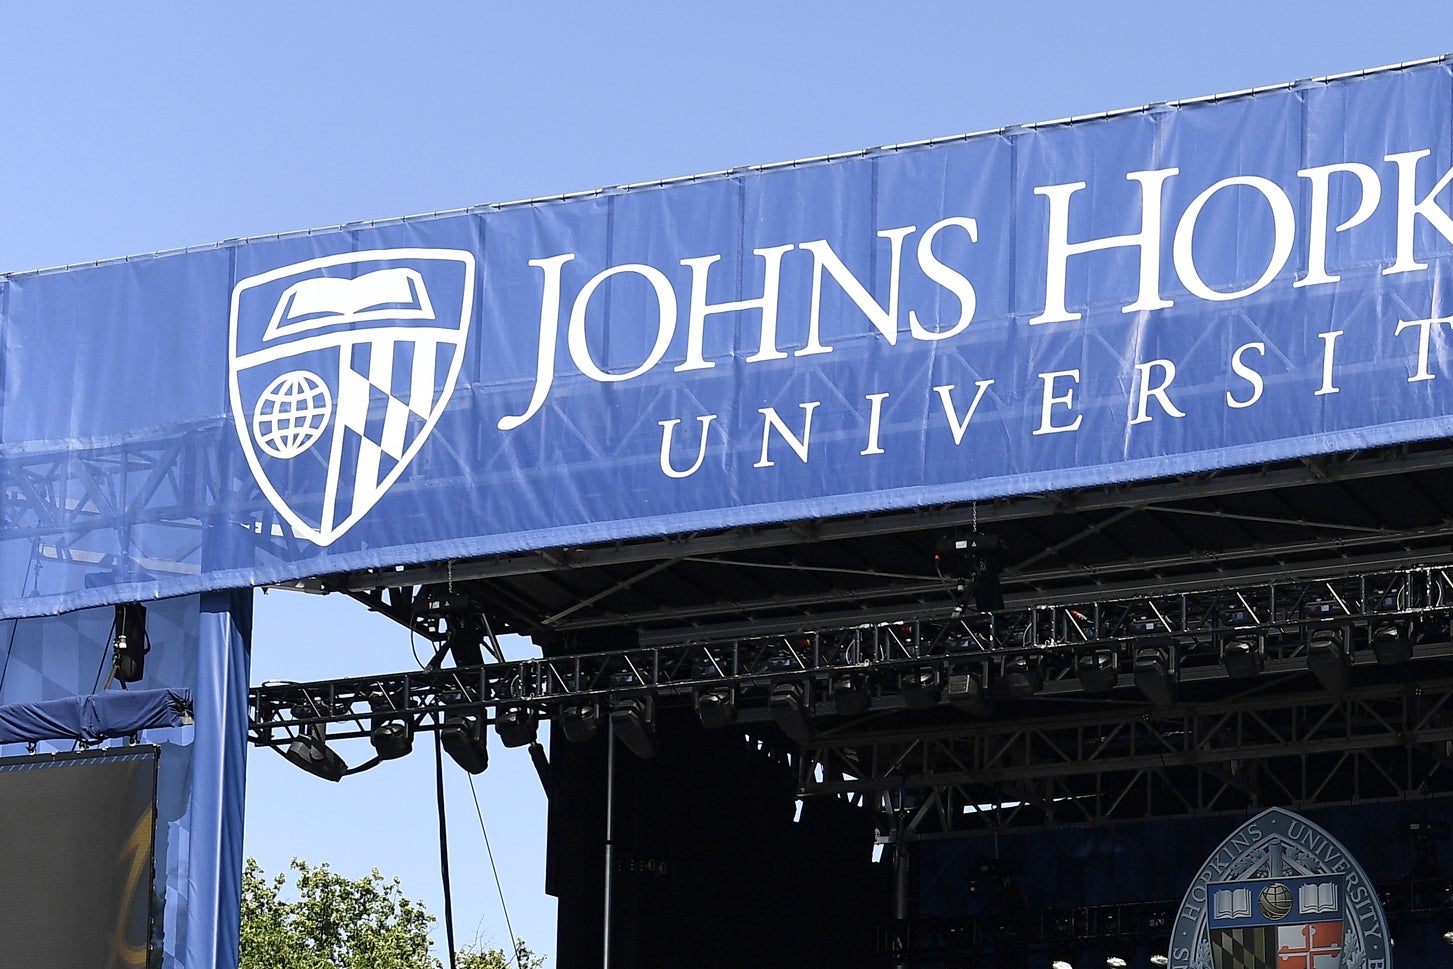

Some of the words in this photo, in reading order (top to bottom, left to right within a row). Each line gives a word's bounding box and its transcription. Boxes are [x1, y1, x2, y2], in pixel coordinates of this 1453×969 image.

[498, 216, 980, 431] JOHNS
[1182, 823, 1262, 921] HOPKINS
[1288, 820, 1382, 938] UNIVERSITY
